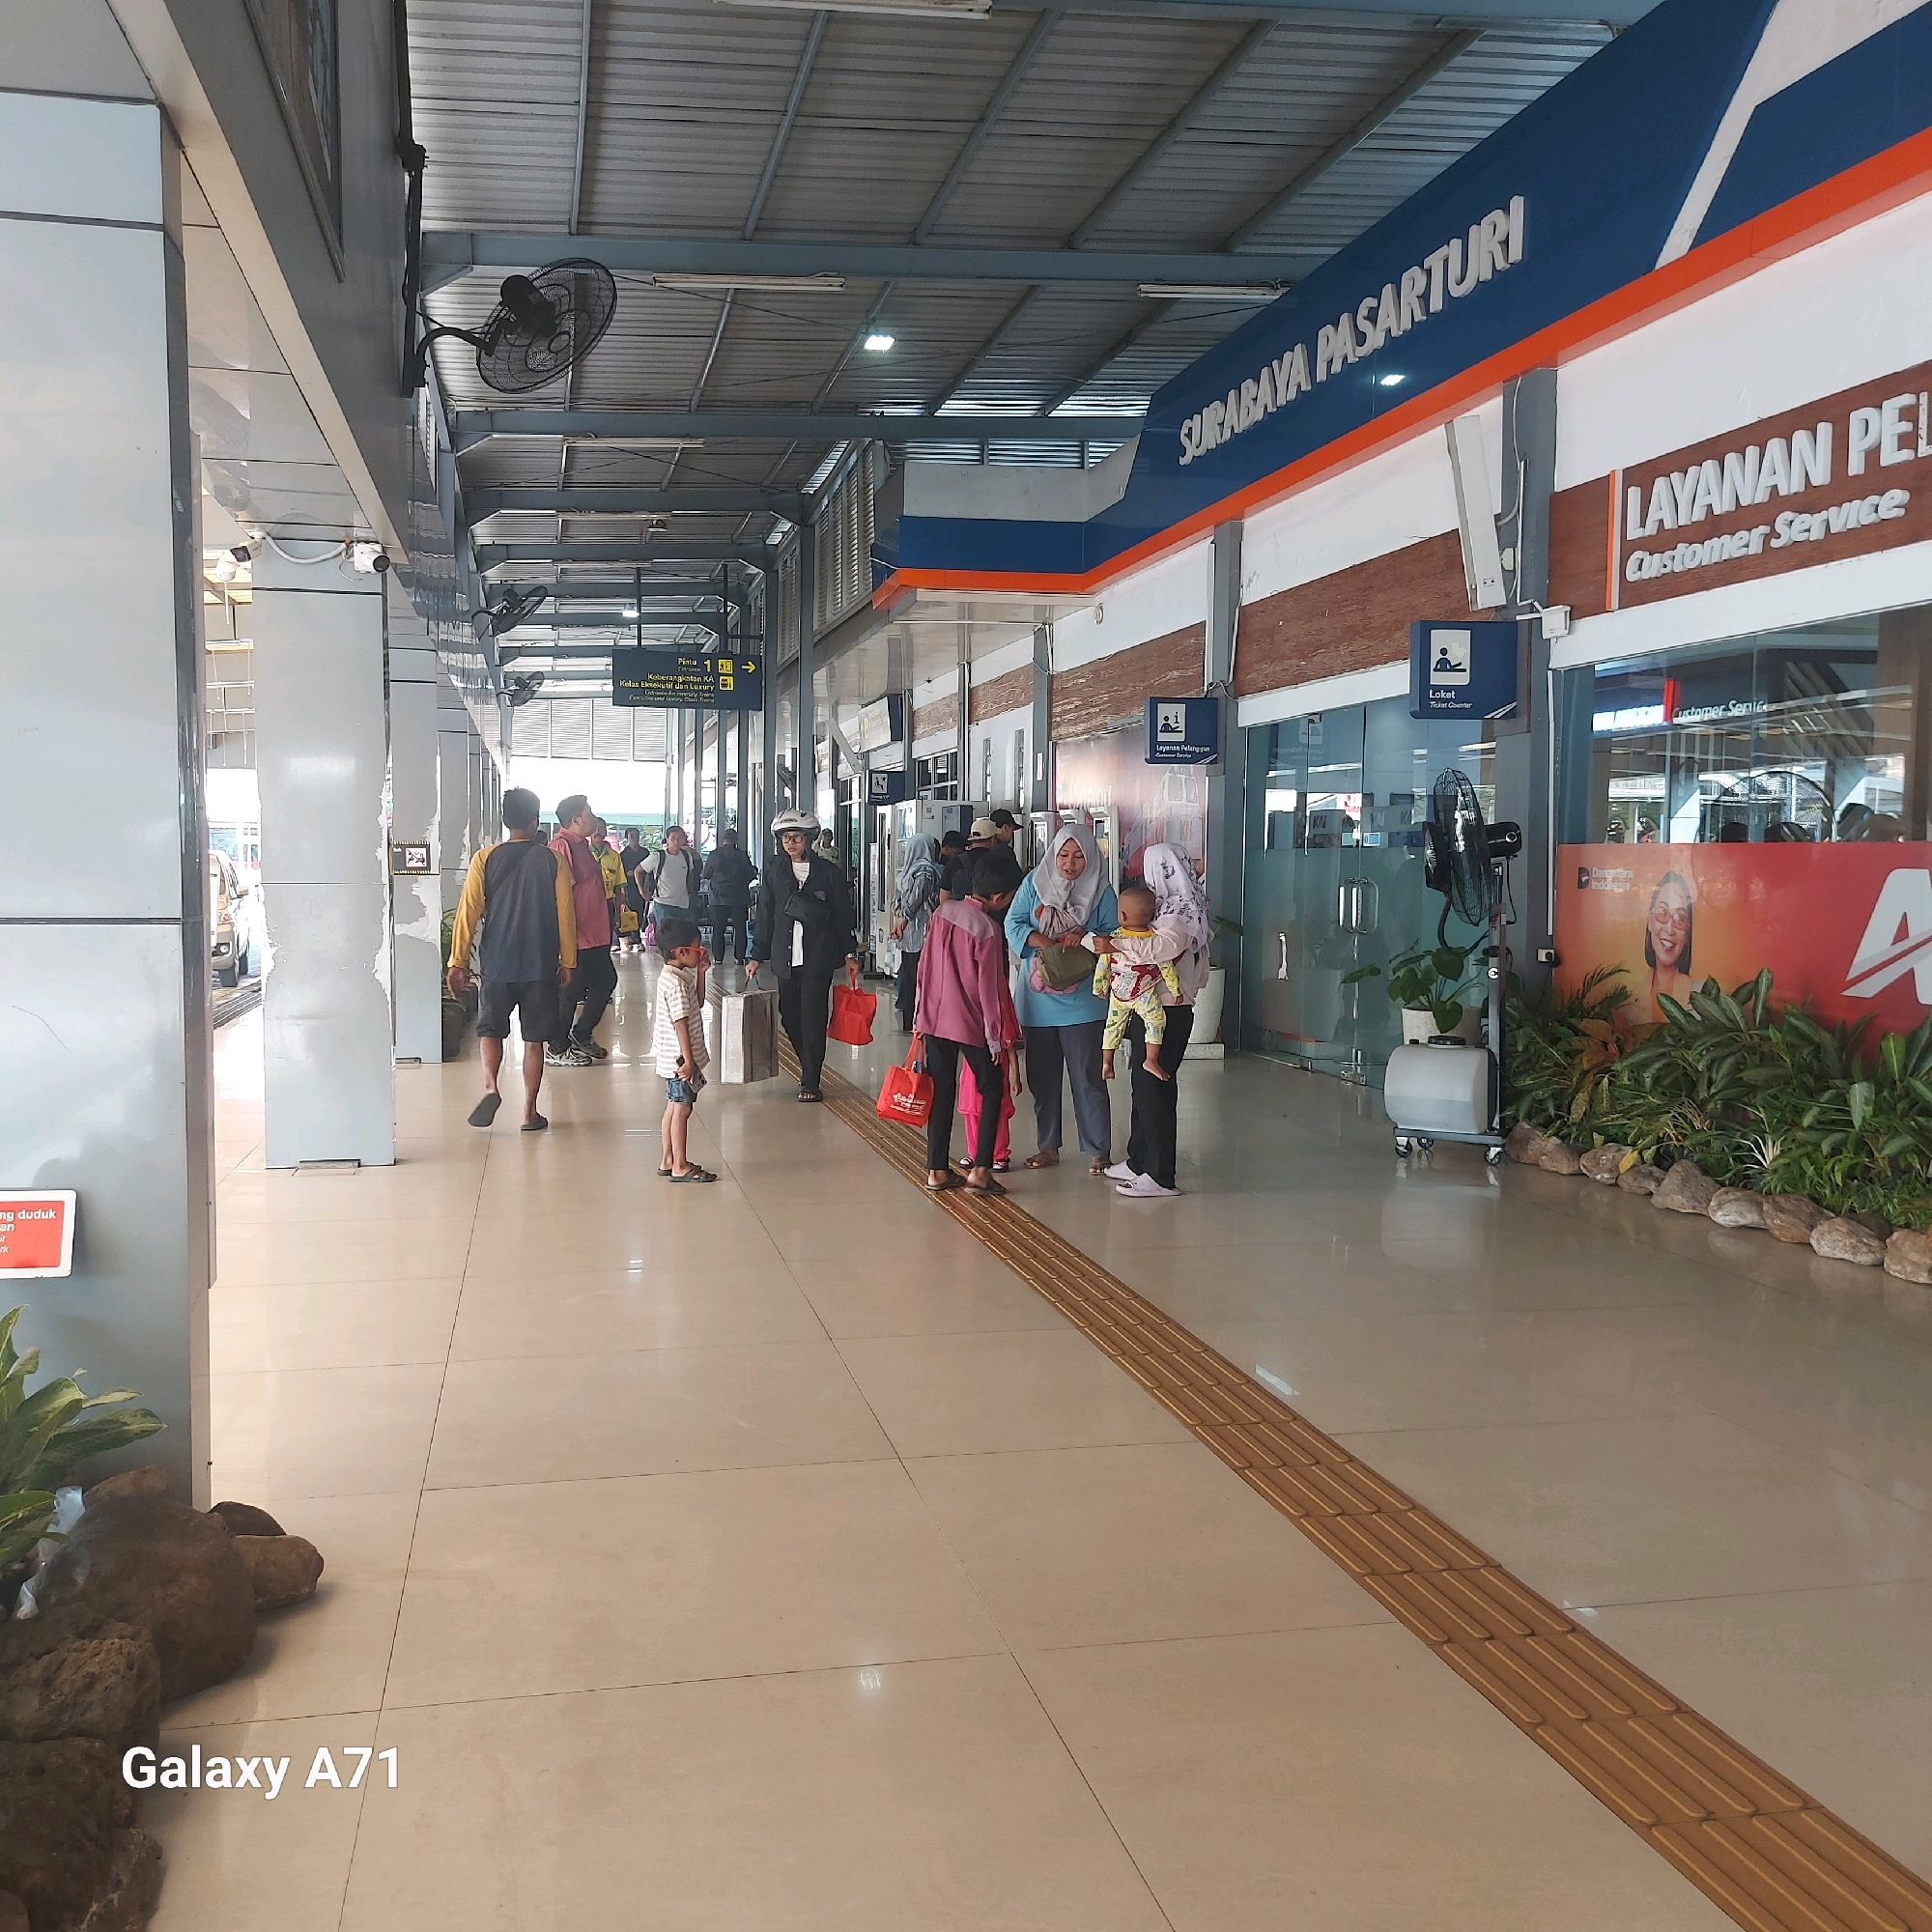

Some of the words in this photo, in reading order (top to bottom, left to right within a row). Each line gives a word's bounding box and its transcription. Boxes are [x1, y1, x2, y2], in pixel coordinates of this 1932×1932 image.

[1178, 343, 1312, 467] SURABAYA
[1316, 195, 1525, 384] PASARTURI
[1626, 421, 1833, 541] LAYANAN
[1848, 391, 1932, 476] PEL
[1625, 524, 1771, 582] Customer
[1770, 488, 1911, 550] Service
[677, 657, 697, 666] Pintu
[703, 659, 712, 672] 1
[647, 671, 702, 683] Keberangkatan
[703, 674, 715, 683] KA
[619, 679, 639, 688] Kelas
[640, 680, 673, 690] Eksekutif
[690, 683, 715, 692] Luxury
[1429, 689, 1456, 699] Loket
[1156, 744, 1180, 753] Layanan
[1180, 744, 1210, 753] Pelanggan
[1591, 867, 1634, 878] Danantara
[1591, 879, 1631, 891] Indonesia
[17, 1208, 57, 1220] duduk
[0, 1223, 15, 1232] an
